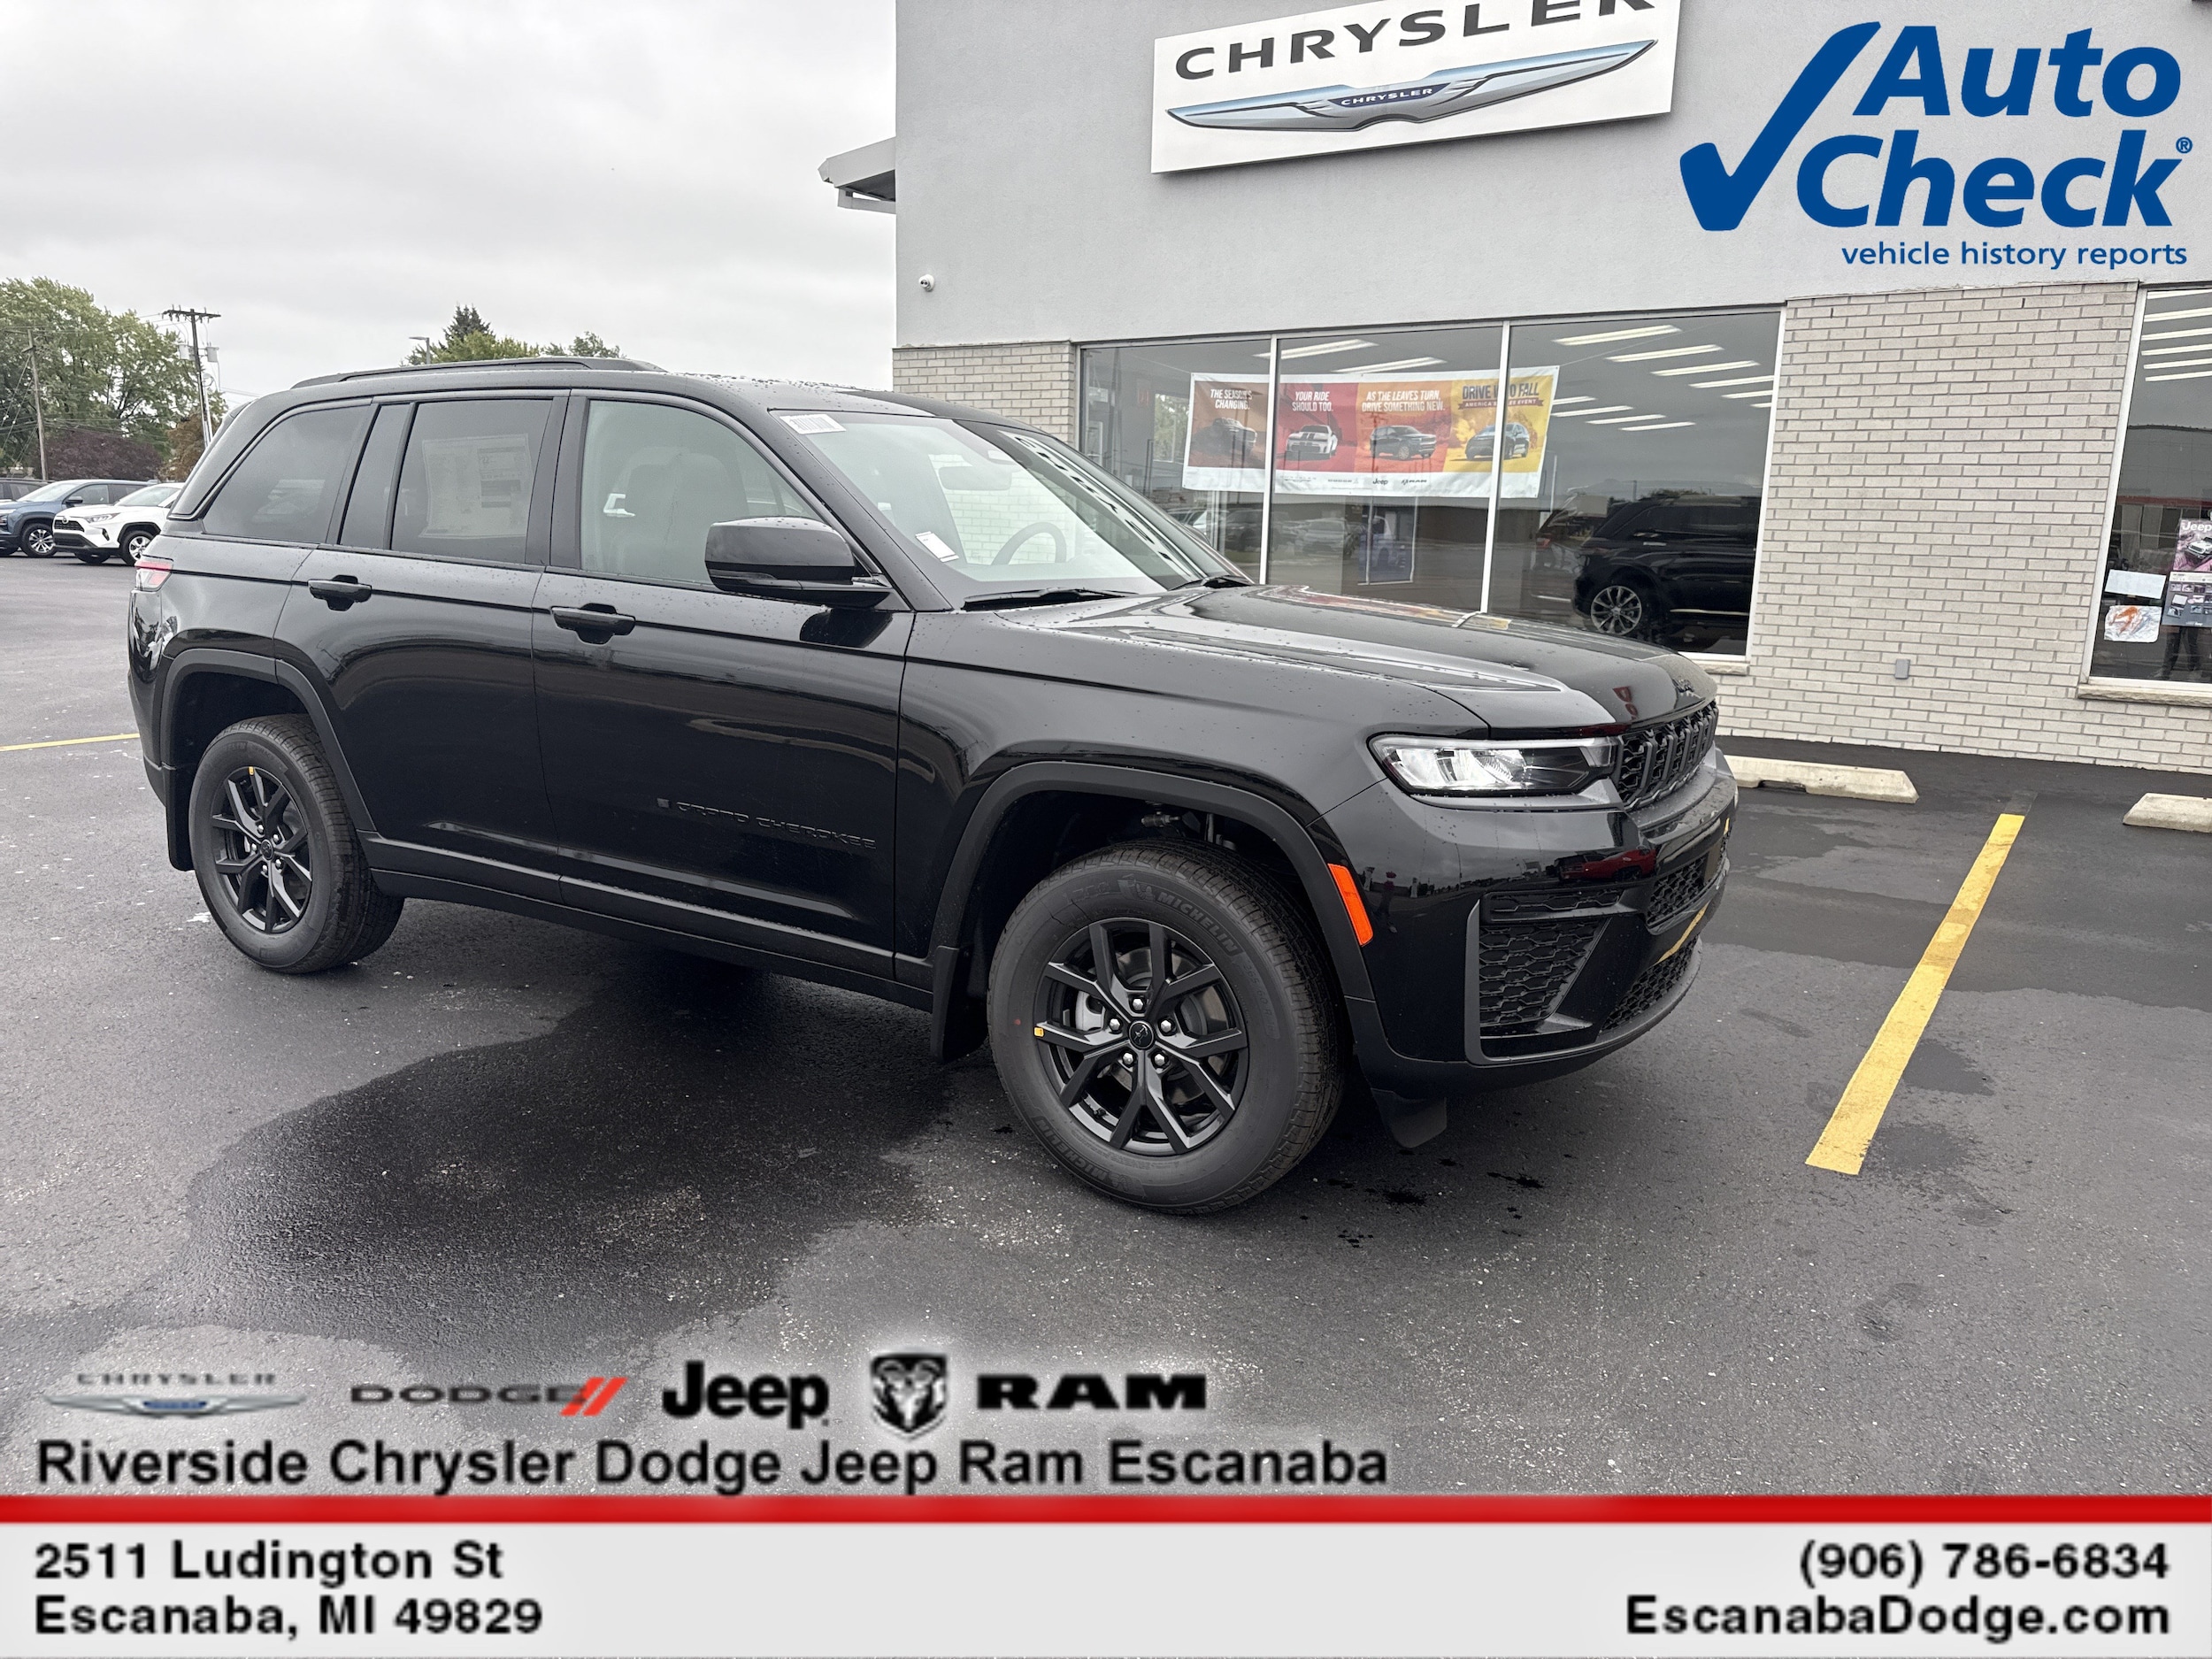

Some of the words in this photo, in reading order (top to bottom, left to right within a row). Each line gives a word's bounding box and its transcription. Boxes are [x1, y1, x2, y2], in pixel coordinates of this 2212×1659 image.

[1340, 88, 1433, 106] CHRYSLER
[1210, 388, 1224, 399] THE
[1294, 391, 1313, 402] YOUR
[1313, 391, 1330, 402] RIDE
[1366, 391, 1376, 402] AS
[1377, 390, 1392, 402] THE
[1392, 390, 1418, 401] LEAVES
[1463, 385, 1492, 400] DRIVE
[1518, 381, 1540, 397] FALL
[1215, 399, 1250, 410] CHANGING.
[1292, 401, 1317, 412] SHOULD
[1362, 402, 1383, 412] DRIVE
[1383, 401, 1425, 412] SOMETHING
[1426, 401, 1446, 411] NEW.
[2182, 521, 2212, 533] Jeep
[1157, 891, 1238, 956] MICHELIN
[1035, 1118, 1109, 1186] MICHELIN
